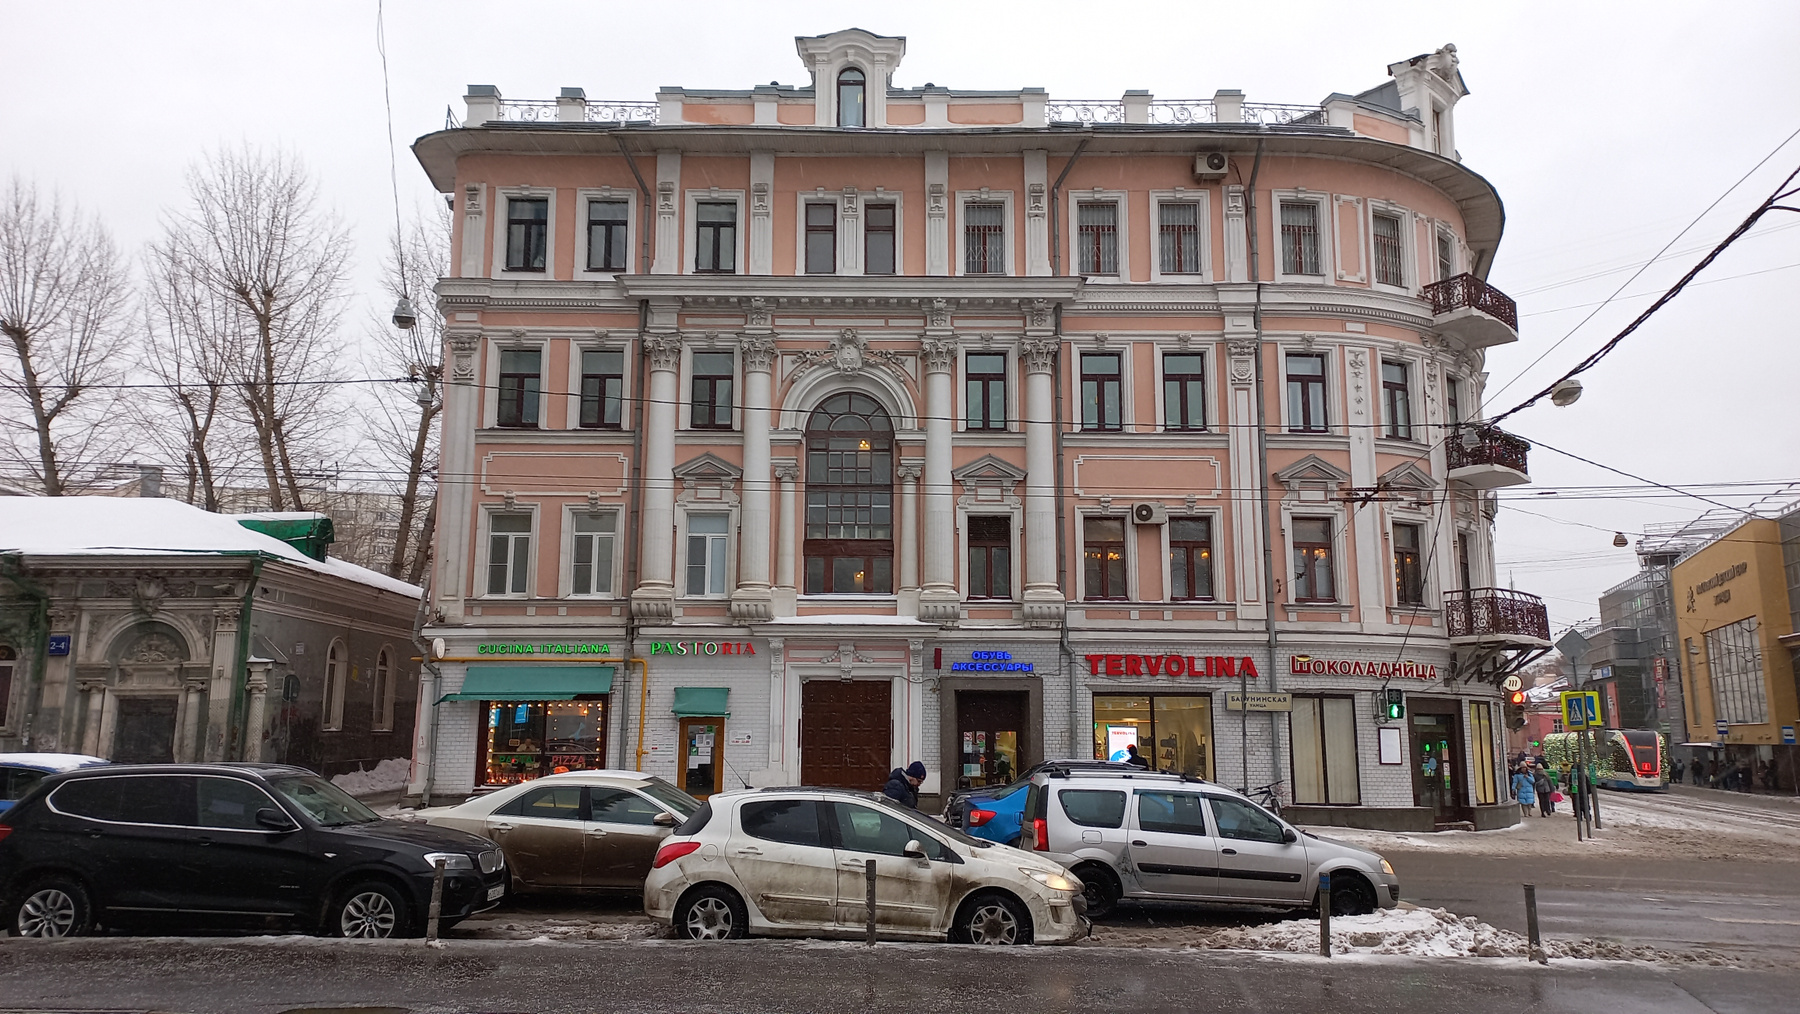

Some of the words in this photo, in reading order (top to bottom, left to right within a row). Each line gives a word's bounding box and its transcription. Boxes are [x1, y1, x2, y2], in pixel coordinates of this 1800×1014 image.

[478, 644, 534, 654] CUCINA
[540, 644, 610, 655] ITALIANA
[651, 641, 756, 656] PASTORIA
[972, 650, 1012, 660] ОБУВЬ
[952, 662, 1034, 672] АКСЕССУАРЫ
[1085, 654, 1259, 677] TERVOLINA
[1290, 654, 1437, 680] ШОКОЛАДНИЦА
[1231, 695, 1287, 703] БАУНИНСКАЯ
[500, 755, 533, 764] PASTA
[552, 755, 585, 765] PIZZA
